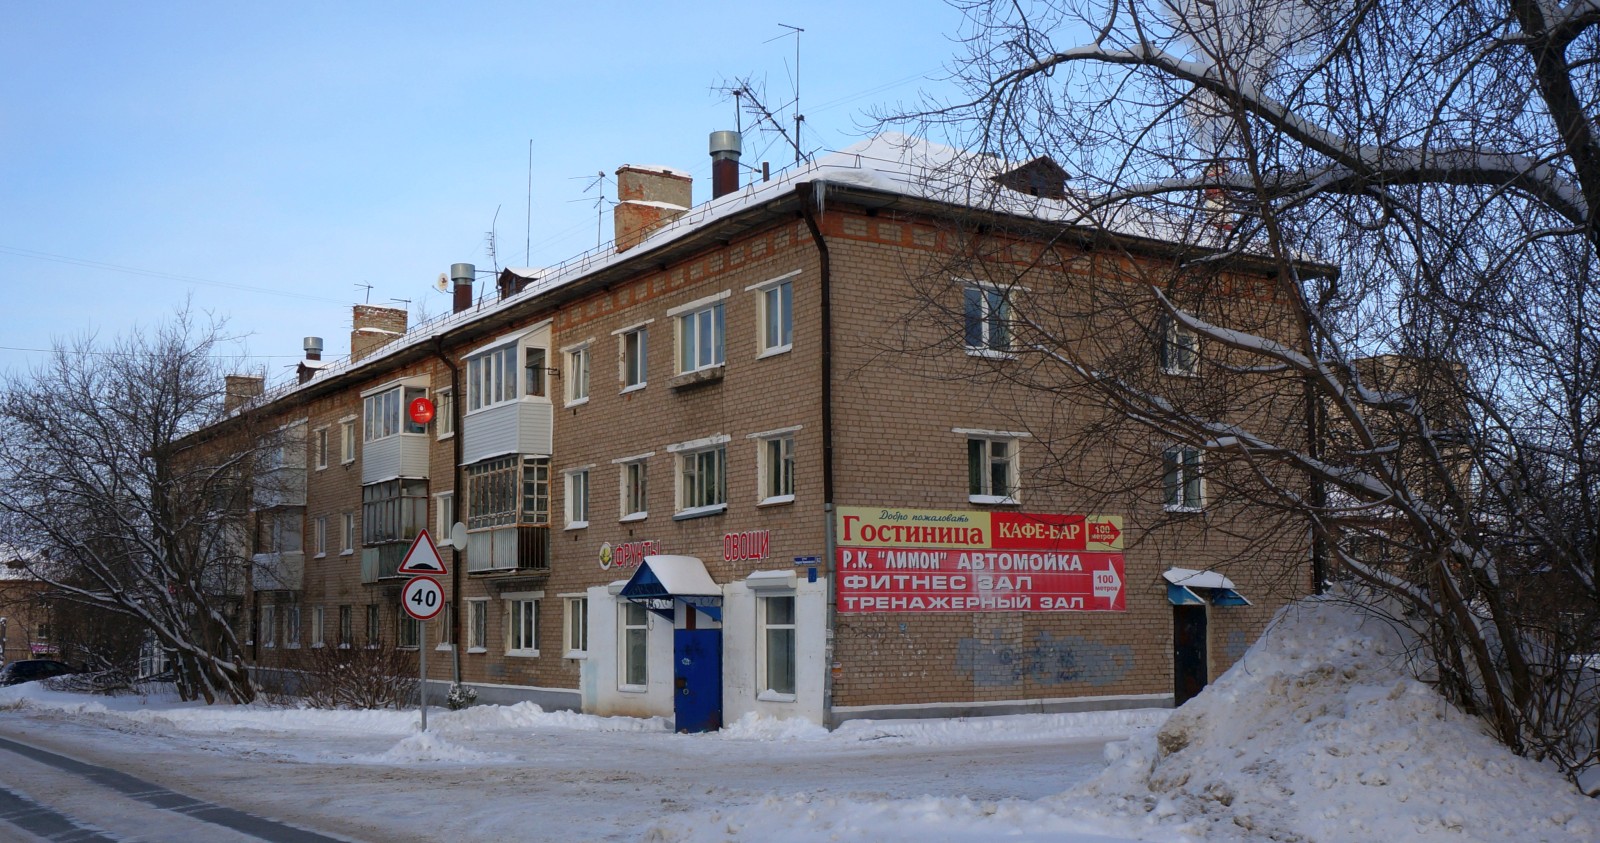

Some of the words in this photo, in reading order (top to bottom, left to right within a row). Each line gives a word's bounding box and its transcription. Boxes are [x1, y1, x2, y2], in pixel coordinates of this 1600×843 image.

[879, 509, 908, 522] Добро
[912, 513, 969, 523] пожаловать
[842, 515, 984, 545] Гостиница
[999, 523, 1080, 540] КАФЕ-БАР
[1094, 525, 1111, 534] 100
[723, 530, 770, 563] ОВОЩИ
[842, 551, 873, 570] Р.К.
[878, 551, 948, 570] "ЛИМОН"
[957, 551, 1083, 571] АВТОМОЙКА
[843, 575, 967, 590] ФИТНЕС
[977, 576, 1033, 590] ЗАЛ
[1096, 575, 1114, 584] 100
[411, 588, 437, 608] 40
[843, 595, 1031, 610] ТРЕНАЖЕРНЫЙ
[1040, 596, 1084, 609] ЗАЛ
